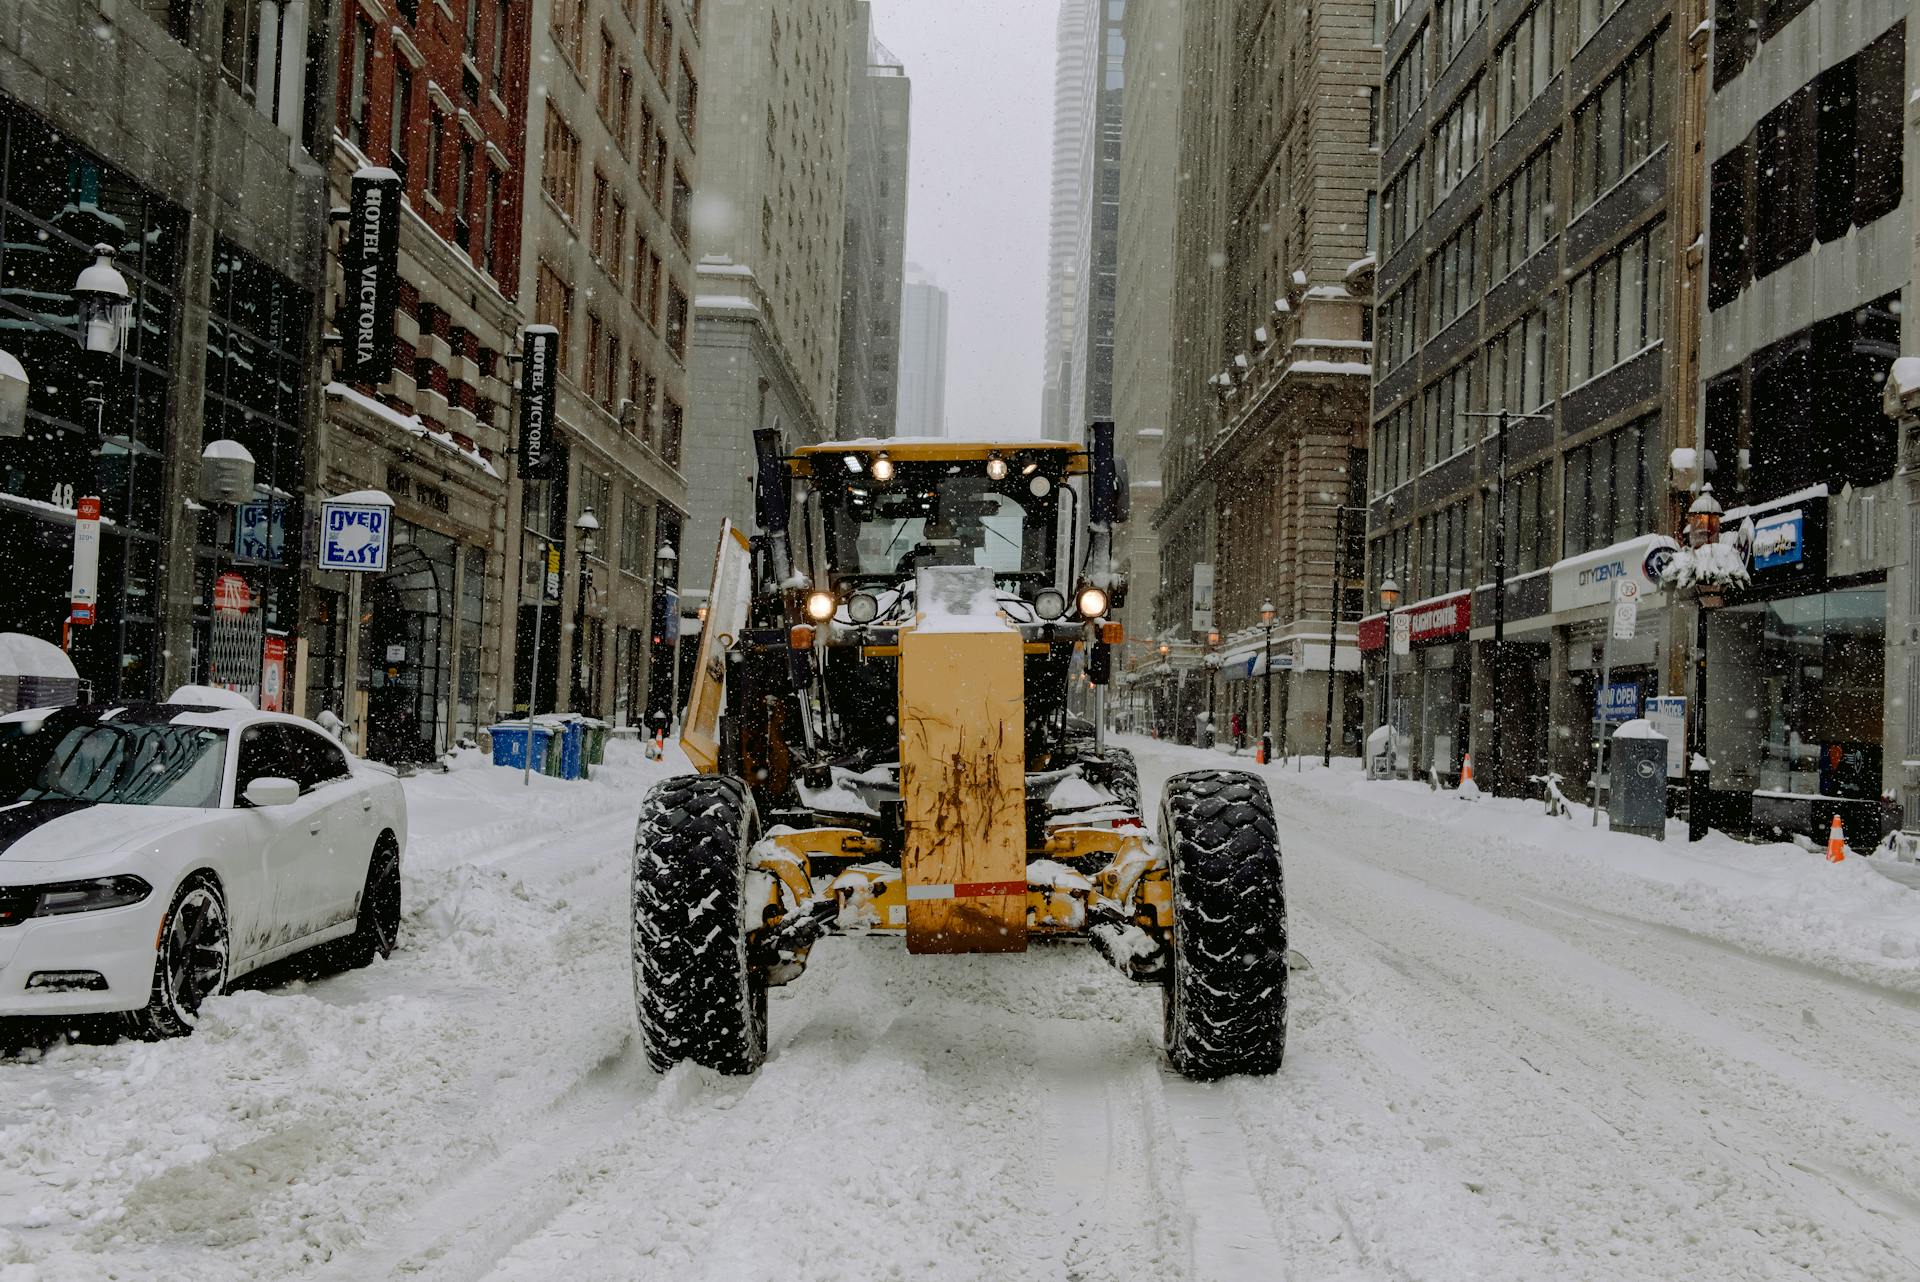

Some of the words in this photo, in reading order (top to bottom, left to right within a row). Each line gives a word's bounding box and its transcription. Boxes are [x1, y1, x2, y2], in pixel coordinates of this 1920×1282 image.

[362, 188, 382, 260] HOTEL
[357, 265, 377, 364] VICTORIA
[531, 337, 546, 391] HOTEL
[528, 394, 543, 467] VICTORIA
[51, 482, 74, 508] 48
[330, 510, 382, 533] OVER
[547, 543, 560, 598] SUBWAY
[1597, 687, 1615, 705] NW
[1616, 686, 1636, 705] OPEN
[1659, 698, 1682, 716] Notice
